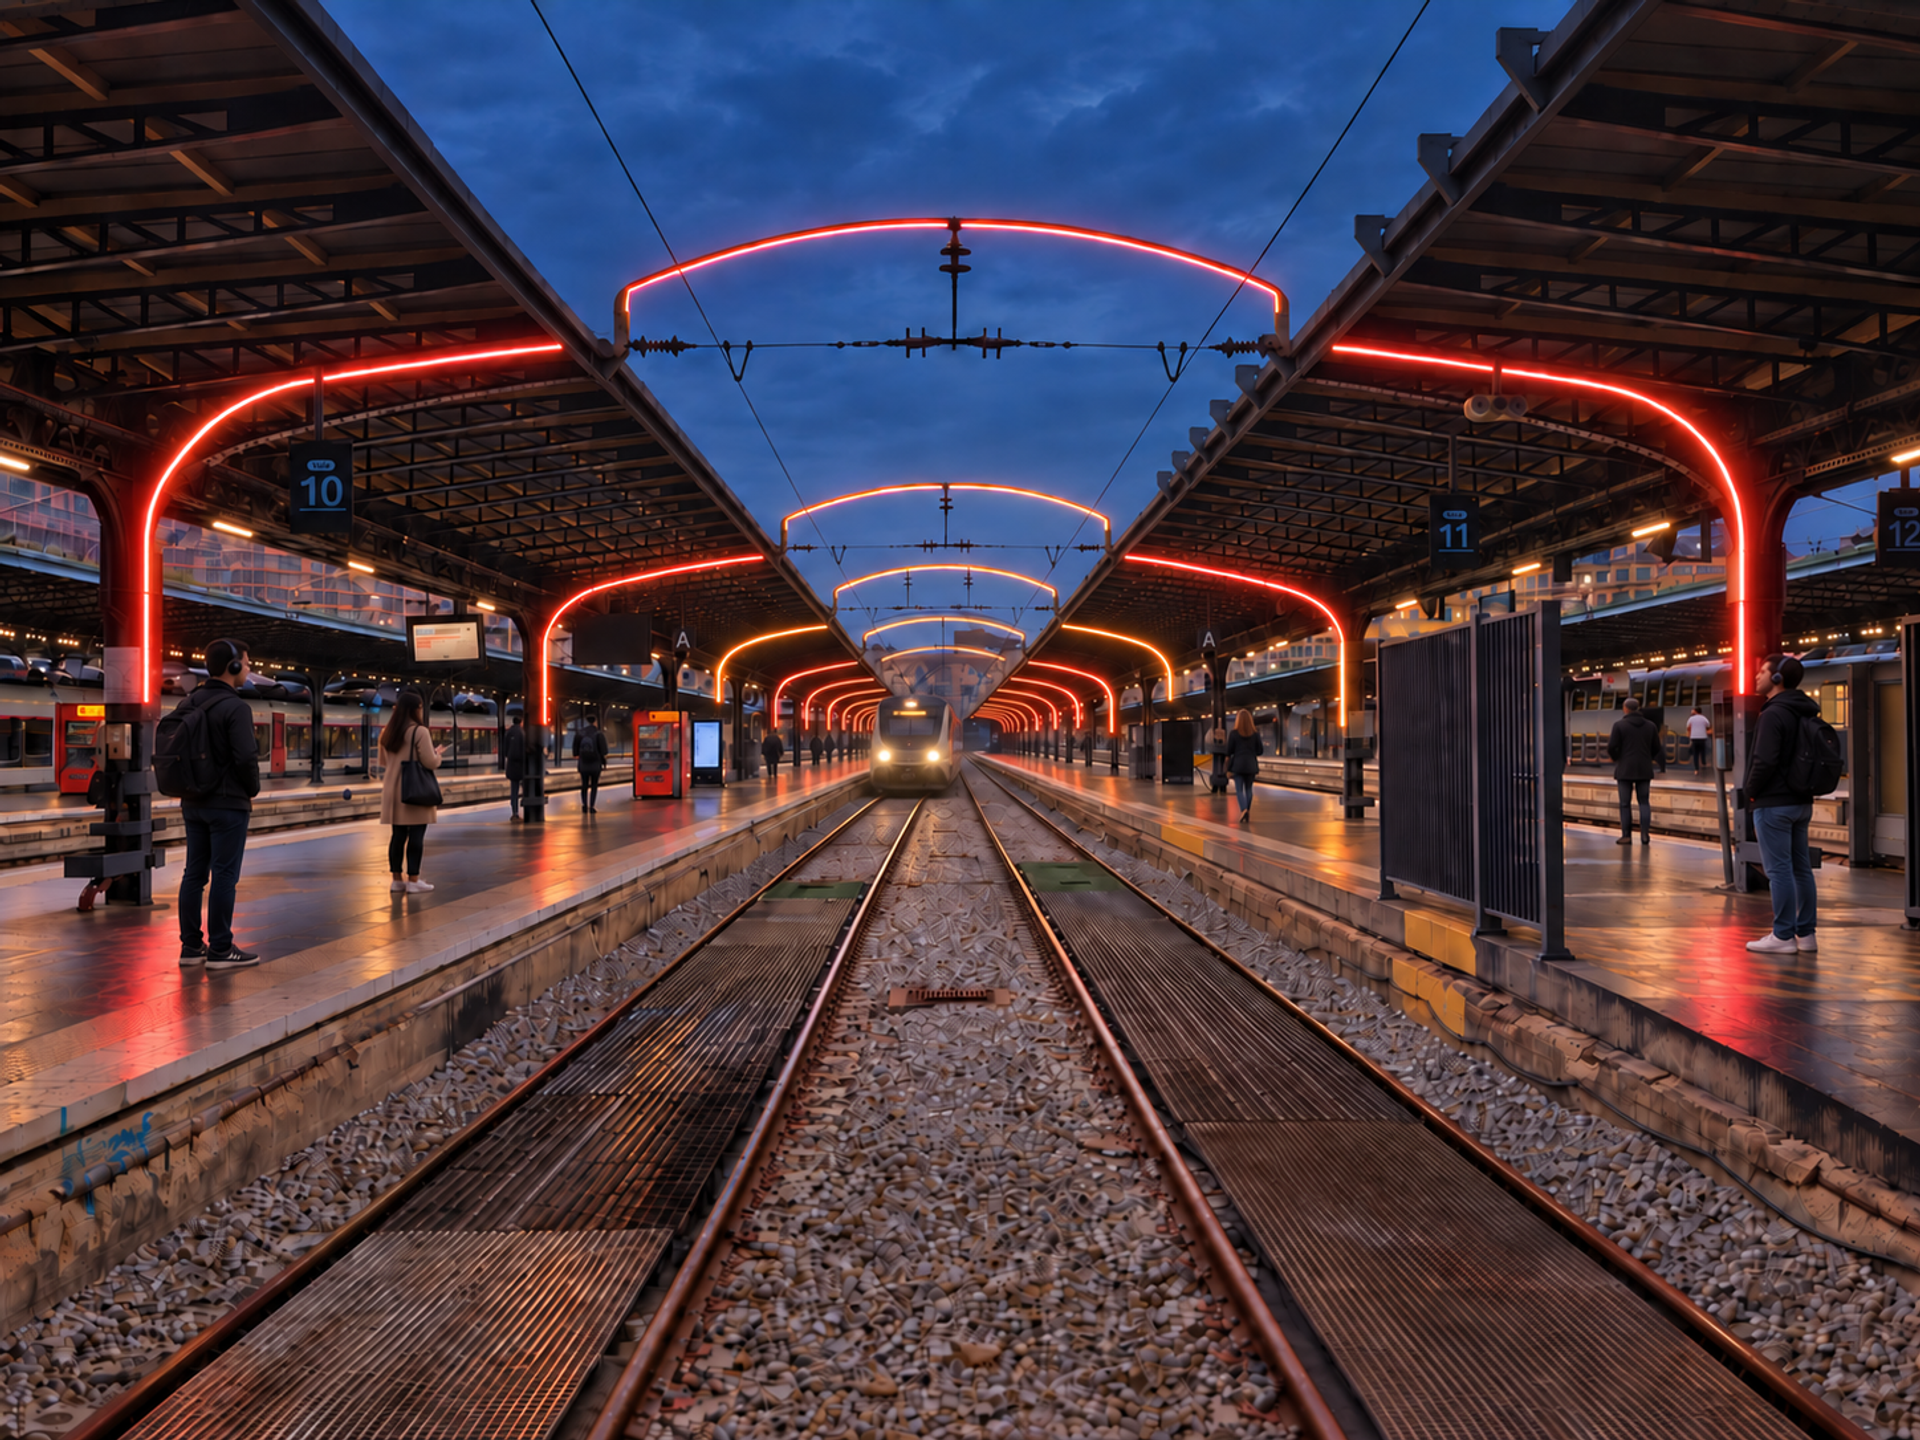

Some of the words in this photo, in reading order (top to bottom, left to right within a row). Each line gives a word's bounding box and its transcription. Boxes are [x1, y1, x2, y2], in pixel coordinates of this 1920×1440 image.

[300, 475, 343, 507] 10
[1439, 523, 1468, 548] 11
[1889, 520, 1920, 547] 12
[676, 631, 691, 648] A
[1202, 631, 1216, 648] A
